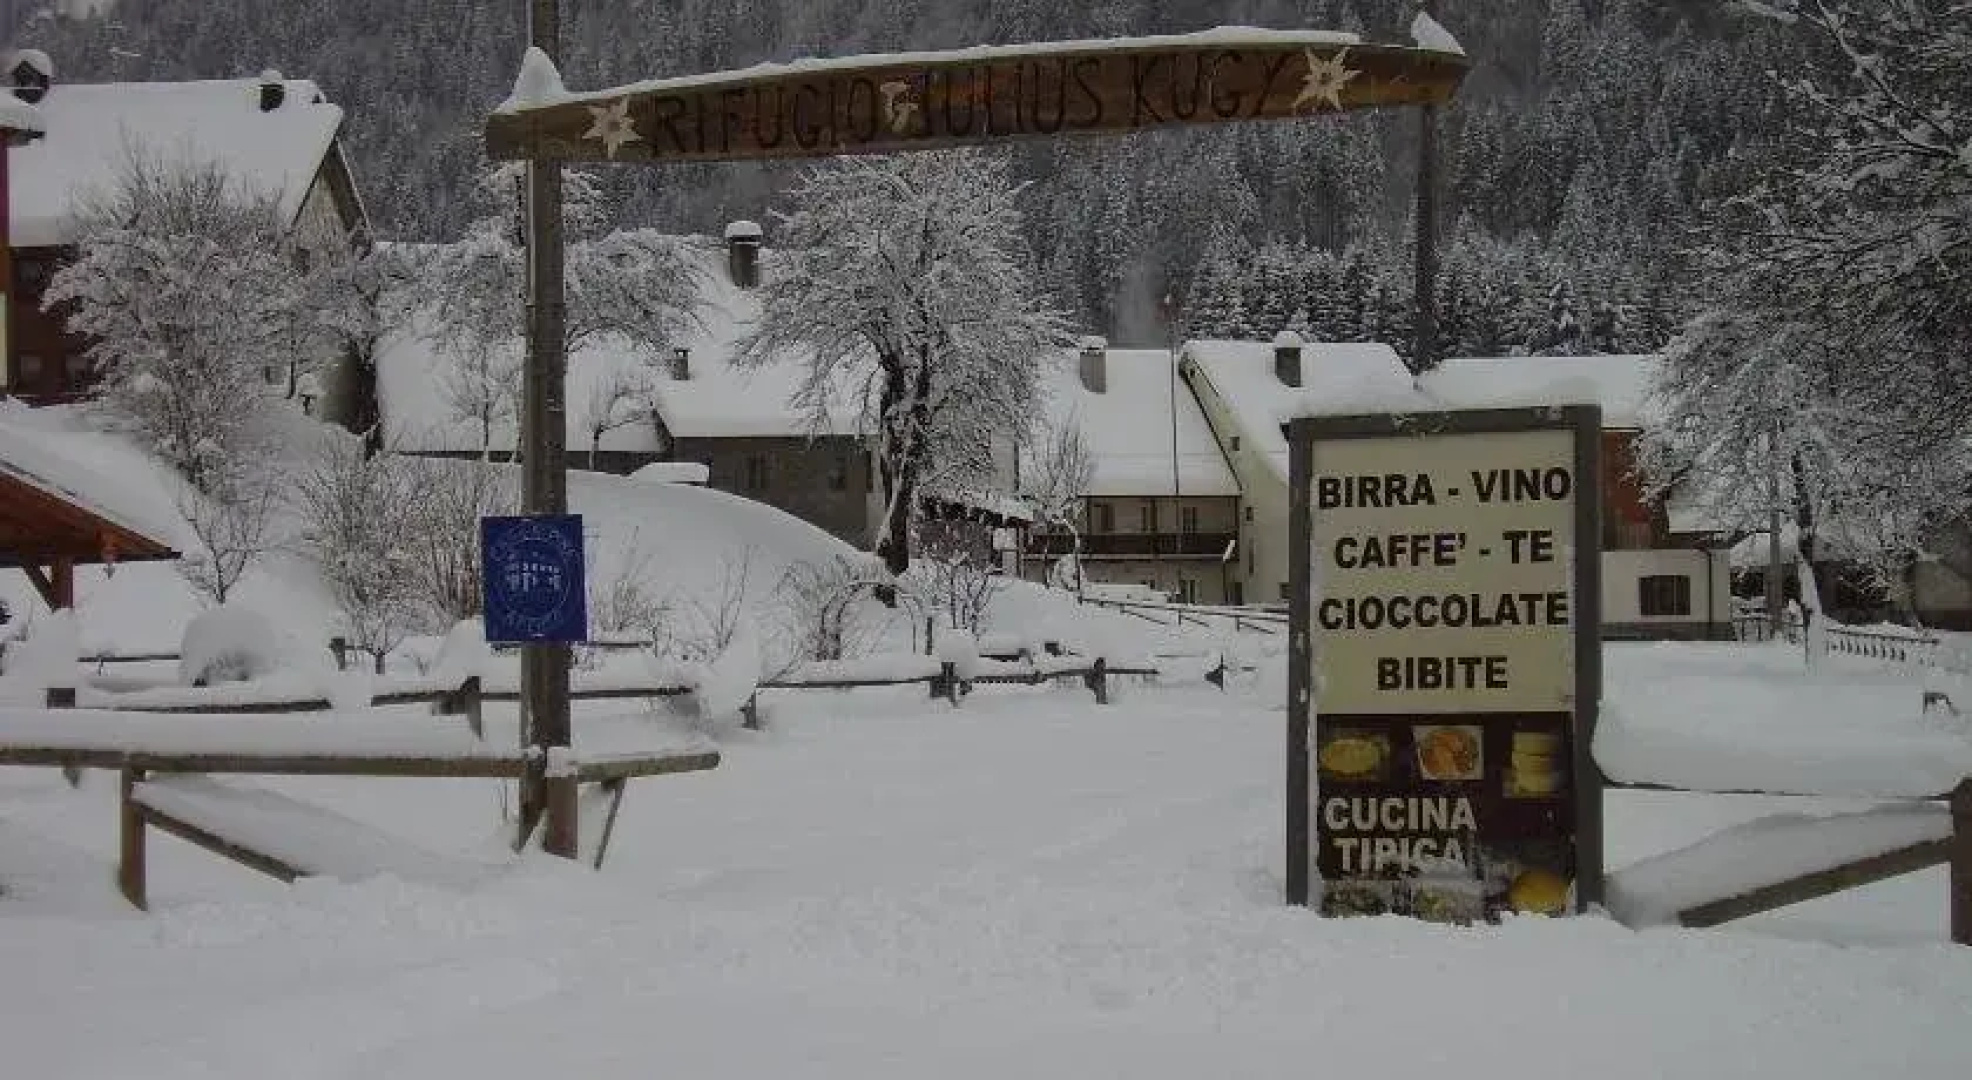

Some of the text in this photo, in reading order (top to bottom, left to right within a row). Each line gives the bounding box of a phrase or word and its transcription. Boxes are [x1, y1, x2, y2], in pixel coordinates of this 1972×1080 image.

[650, 48, 1306, 156] RIFUGIO JULIUS KUGY
[1318, 473, 1436, 509] BIRRA
[1471, 466, 1571, 502] VINO
[1503, 530, 1553, 564] TE
[1319, 591, 1569, 630] CIOCCOLATE
[1377, 657, 1508, 690] BIBITE
[1325, 797, 1477, 831] CUCINA
